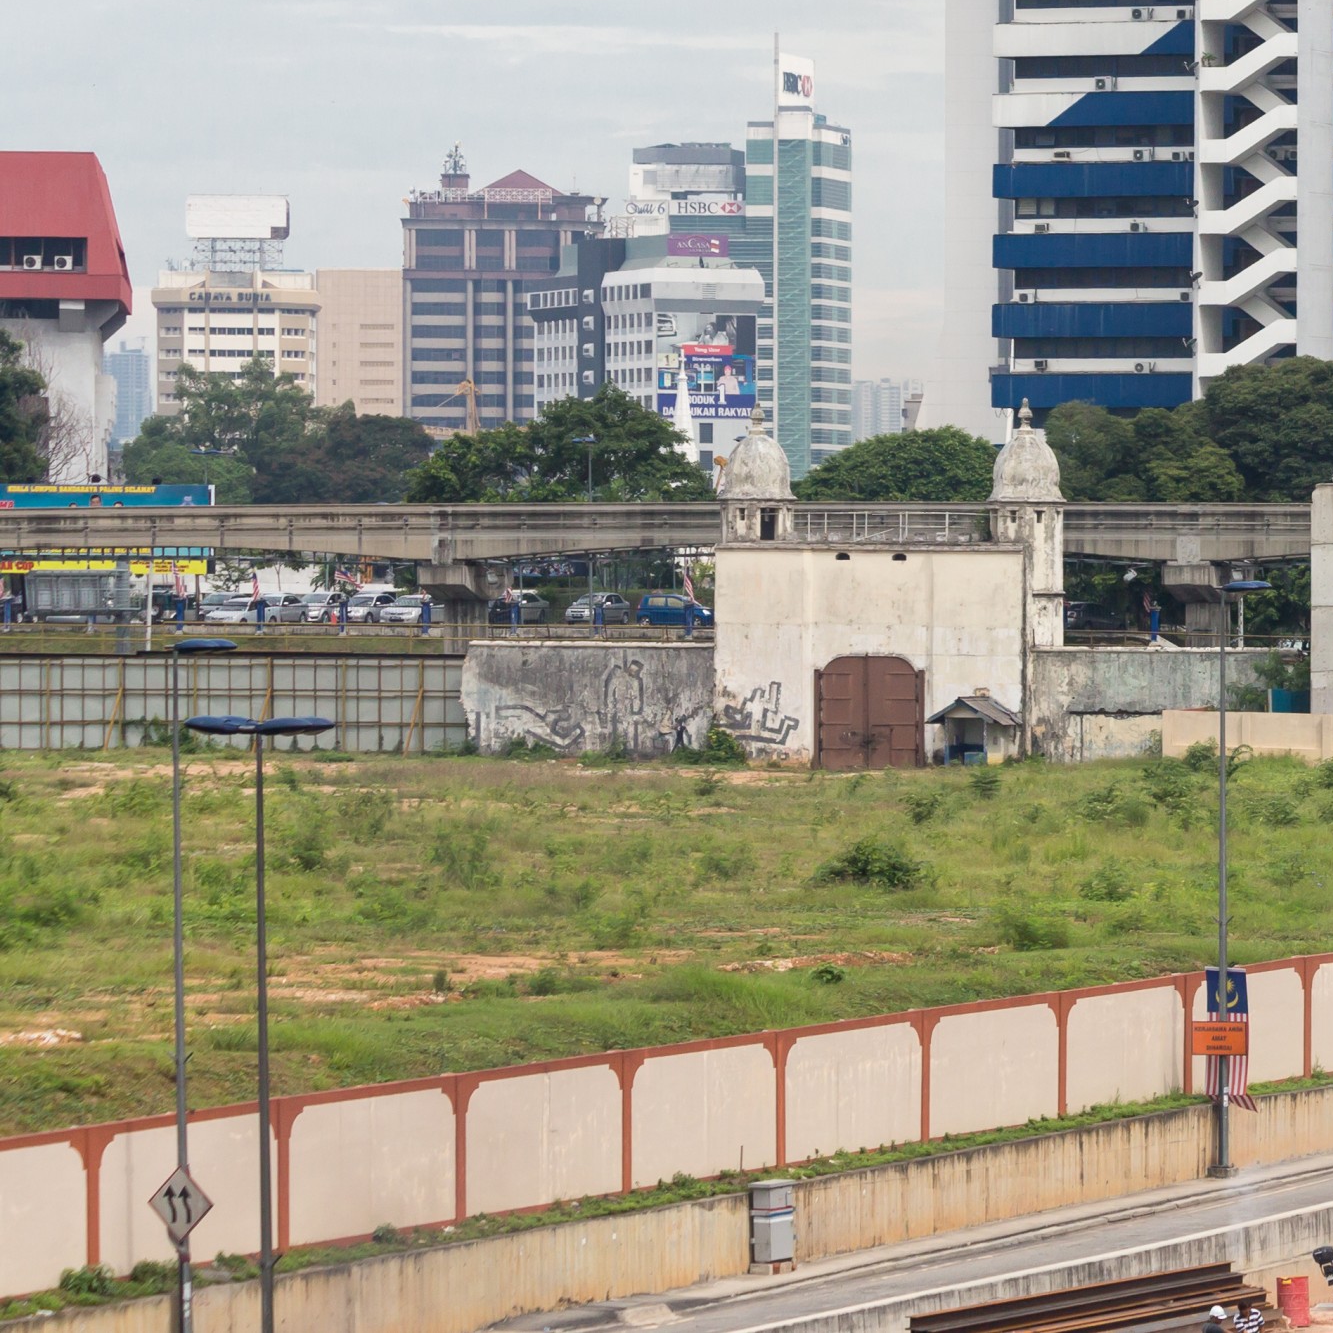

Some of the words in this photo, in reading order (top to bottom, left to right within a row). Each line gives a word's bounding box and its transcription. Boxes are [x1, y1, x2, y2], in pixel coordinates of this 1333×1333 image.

[657, 200, 666, 214] 6
[677, 201, 718, 214] HSBC
[717, 383, 727, 405] 1
[718, 407, 752, 417] RAKYAT
